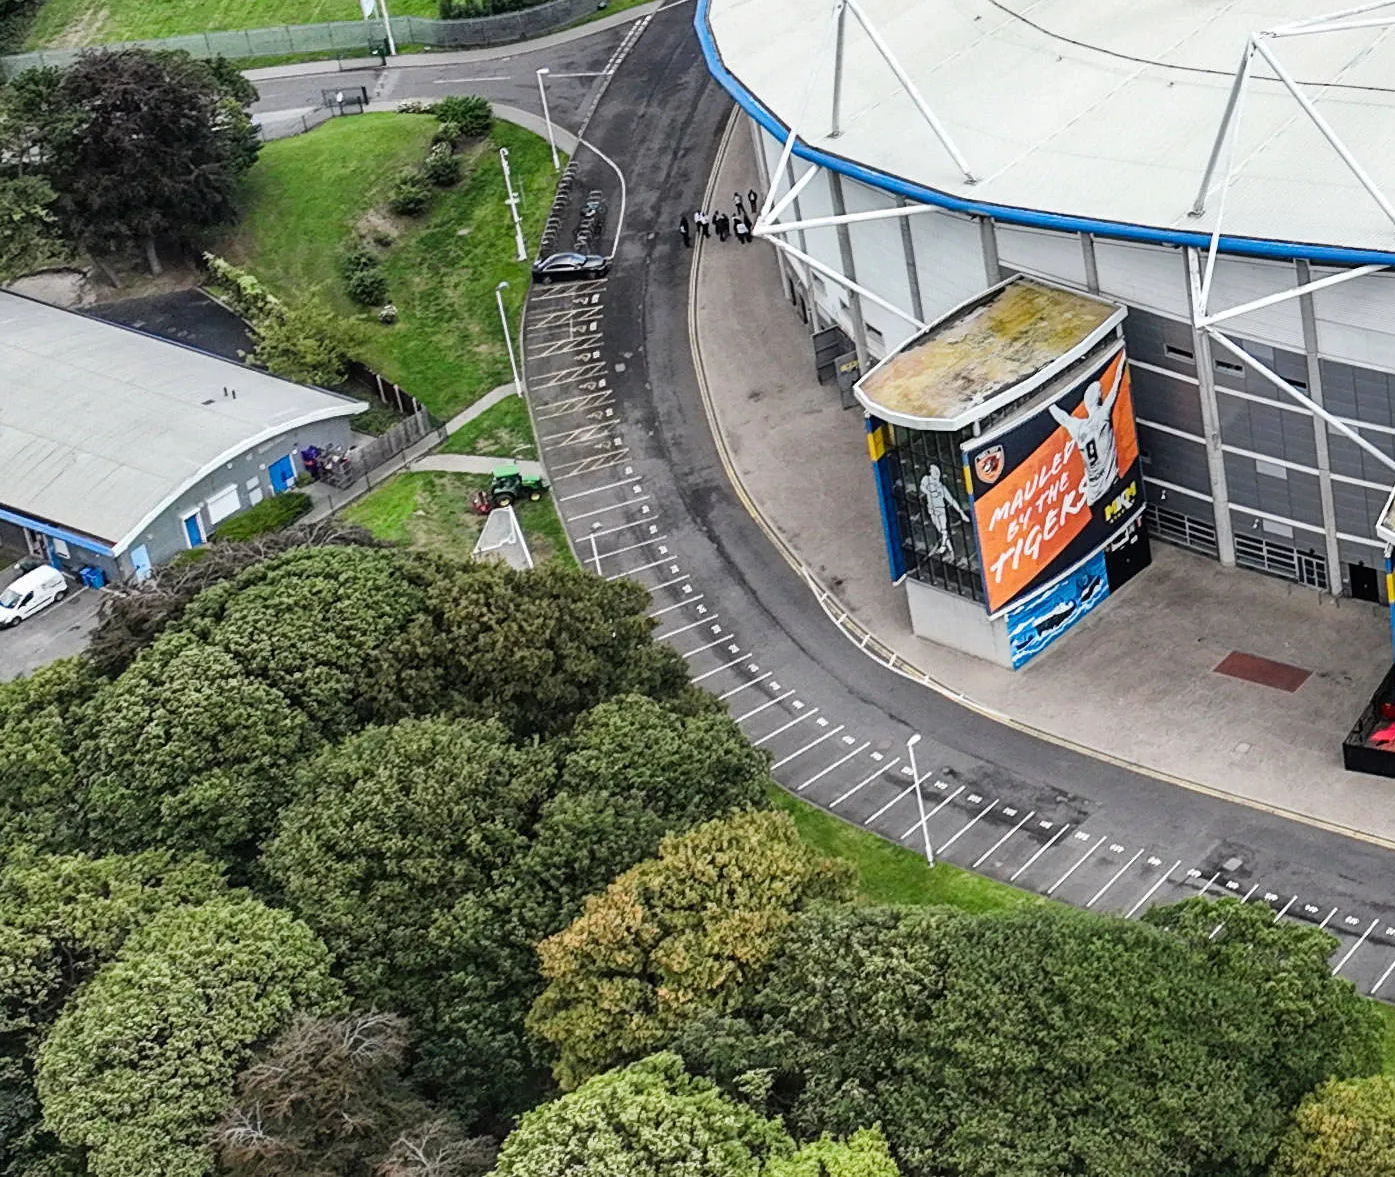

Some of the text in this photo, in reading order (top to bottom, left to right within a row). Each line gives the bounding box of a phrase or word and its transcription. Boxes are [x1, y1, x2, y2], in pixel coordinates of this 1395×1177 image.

[988, 439, 1076, 531] MAULED
[1086, 437, 1098, 466] 9
[990, 475, 1088, 584] TIGERS
[1007, 471, 1070, 543] BY THE
